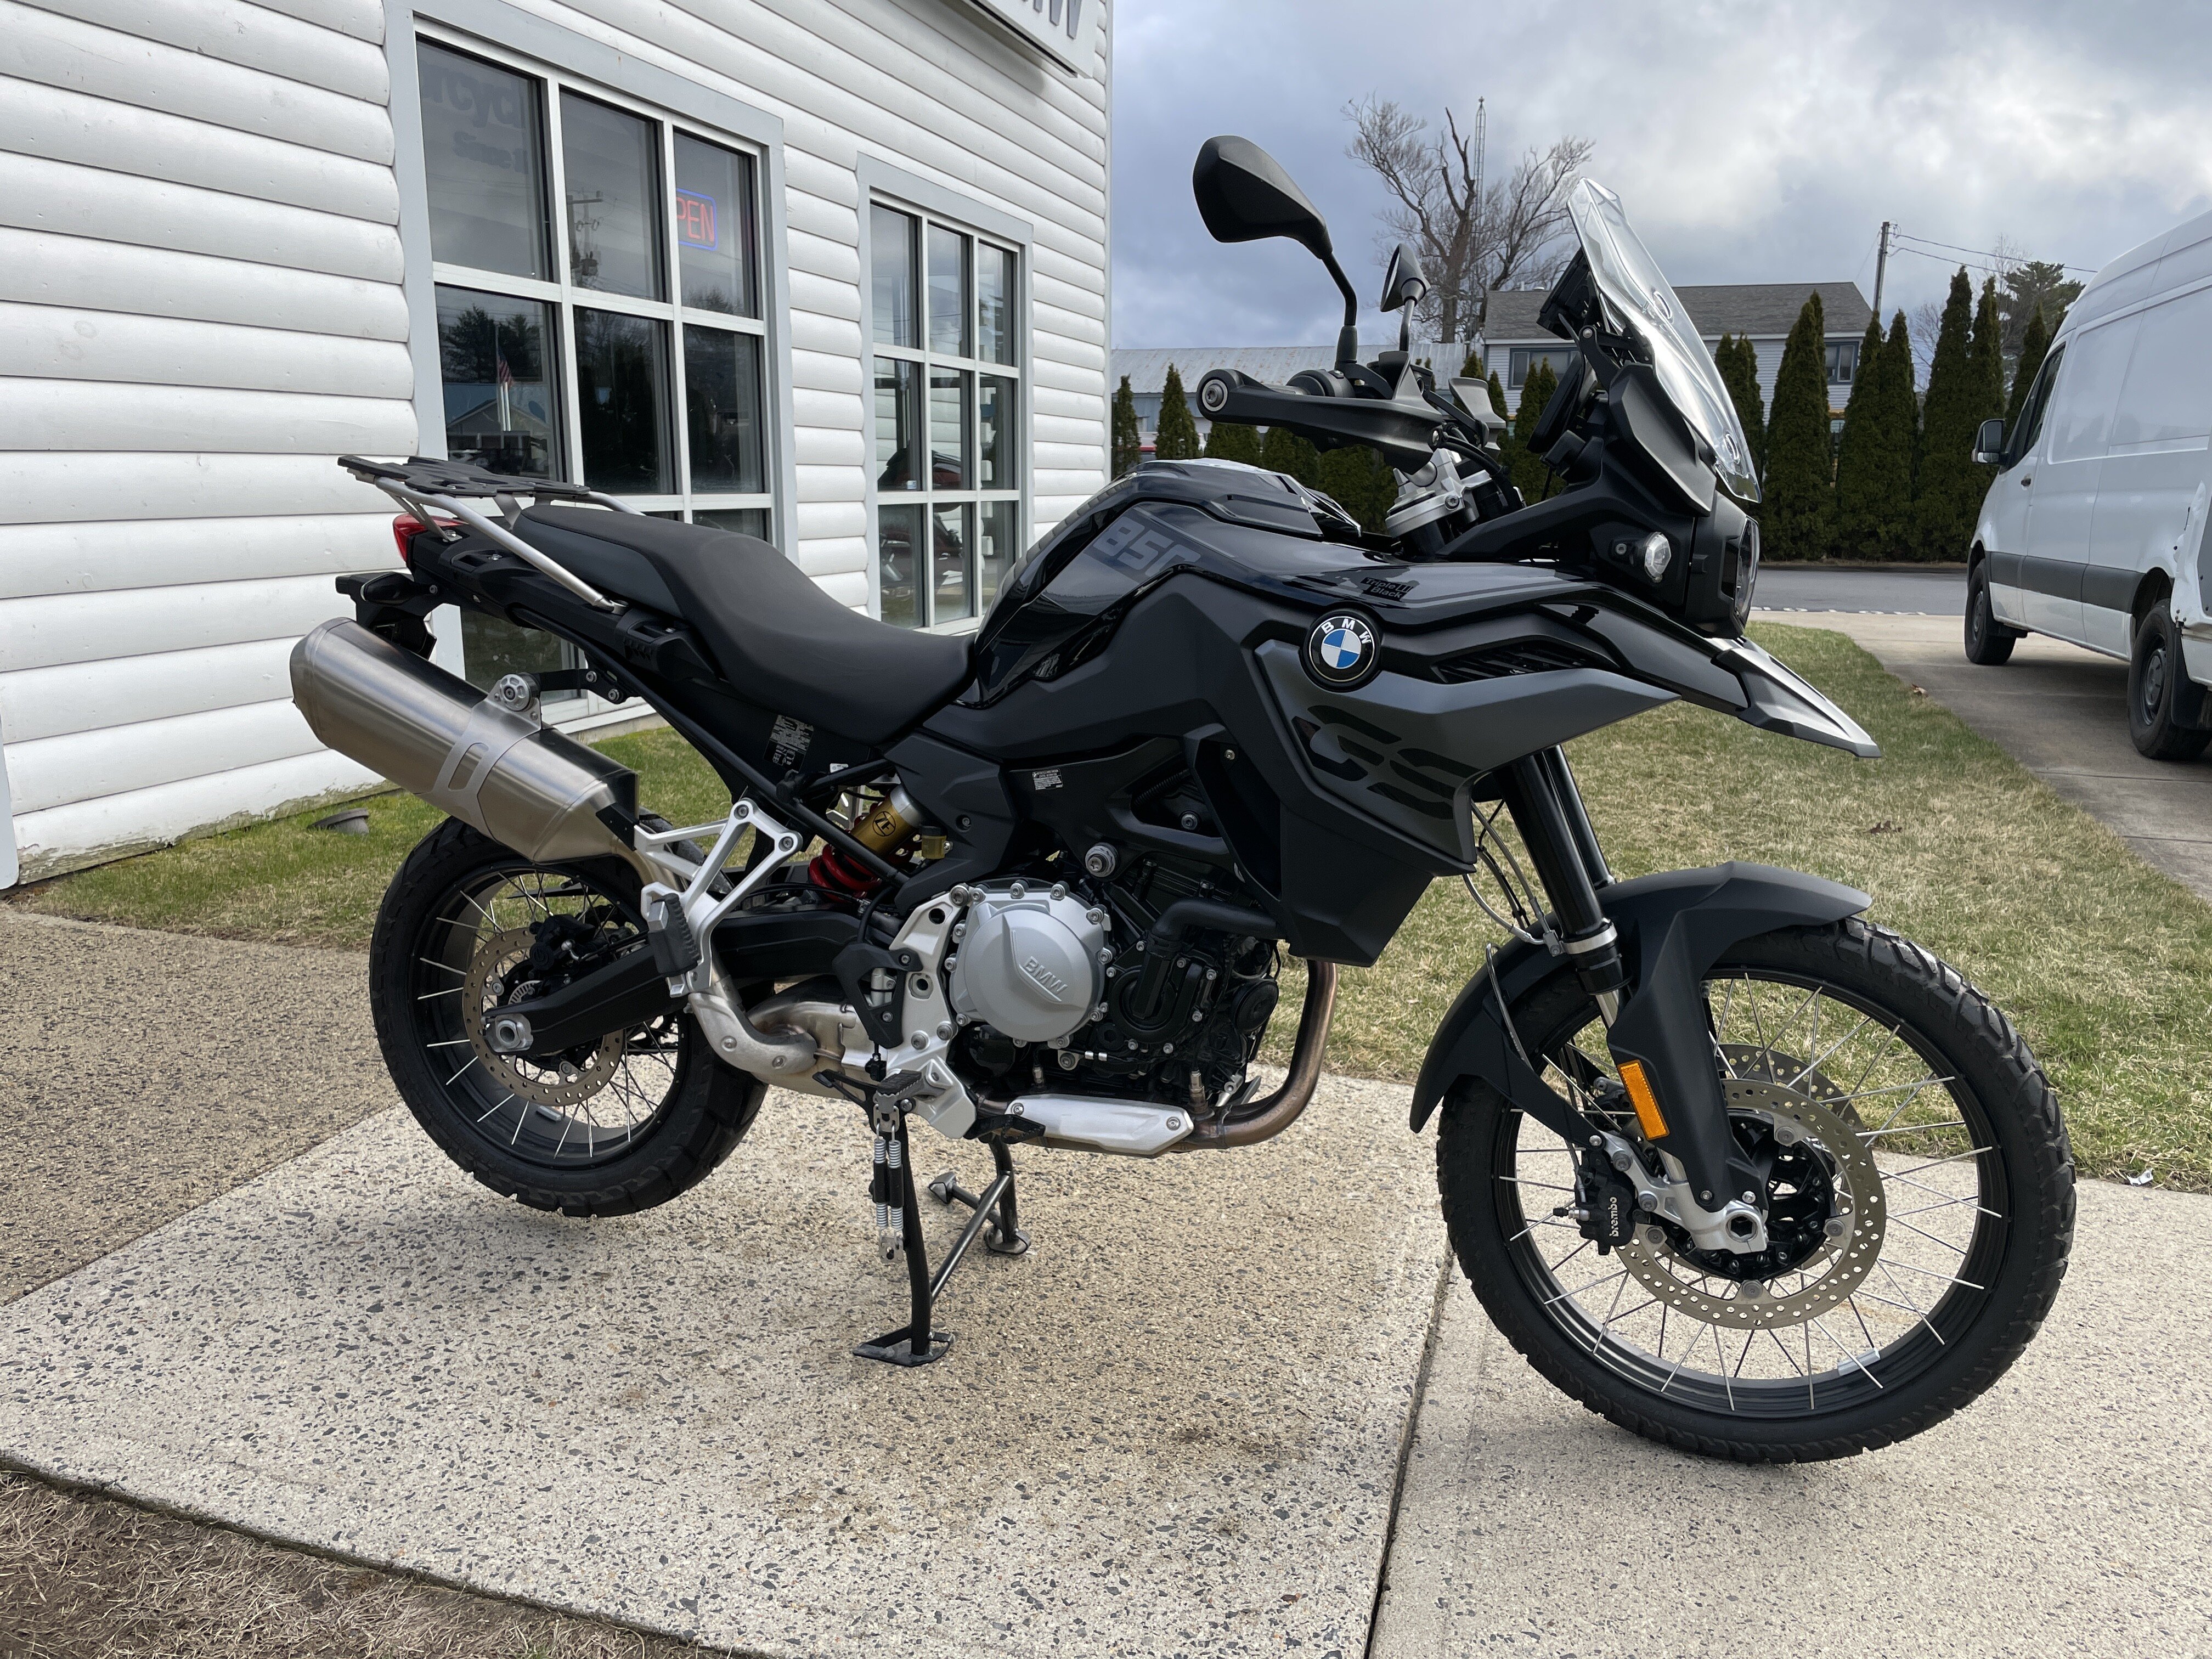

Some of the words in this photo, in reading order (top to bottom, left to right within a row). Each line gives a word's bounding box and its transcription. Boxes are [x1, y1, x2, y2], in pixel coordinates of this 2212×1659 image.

[676, 196, 714, 242] PEN
[1365, 578, 1396, 589] Triple
[1370, 586, 1402, 599] Black
[1321, 618, 1372, 644] BMW
[1024, 956, 1068, 995] BMW
[1607, 1197, 1619, 1237] brembo
